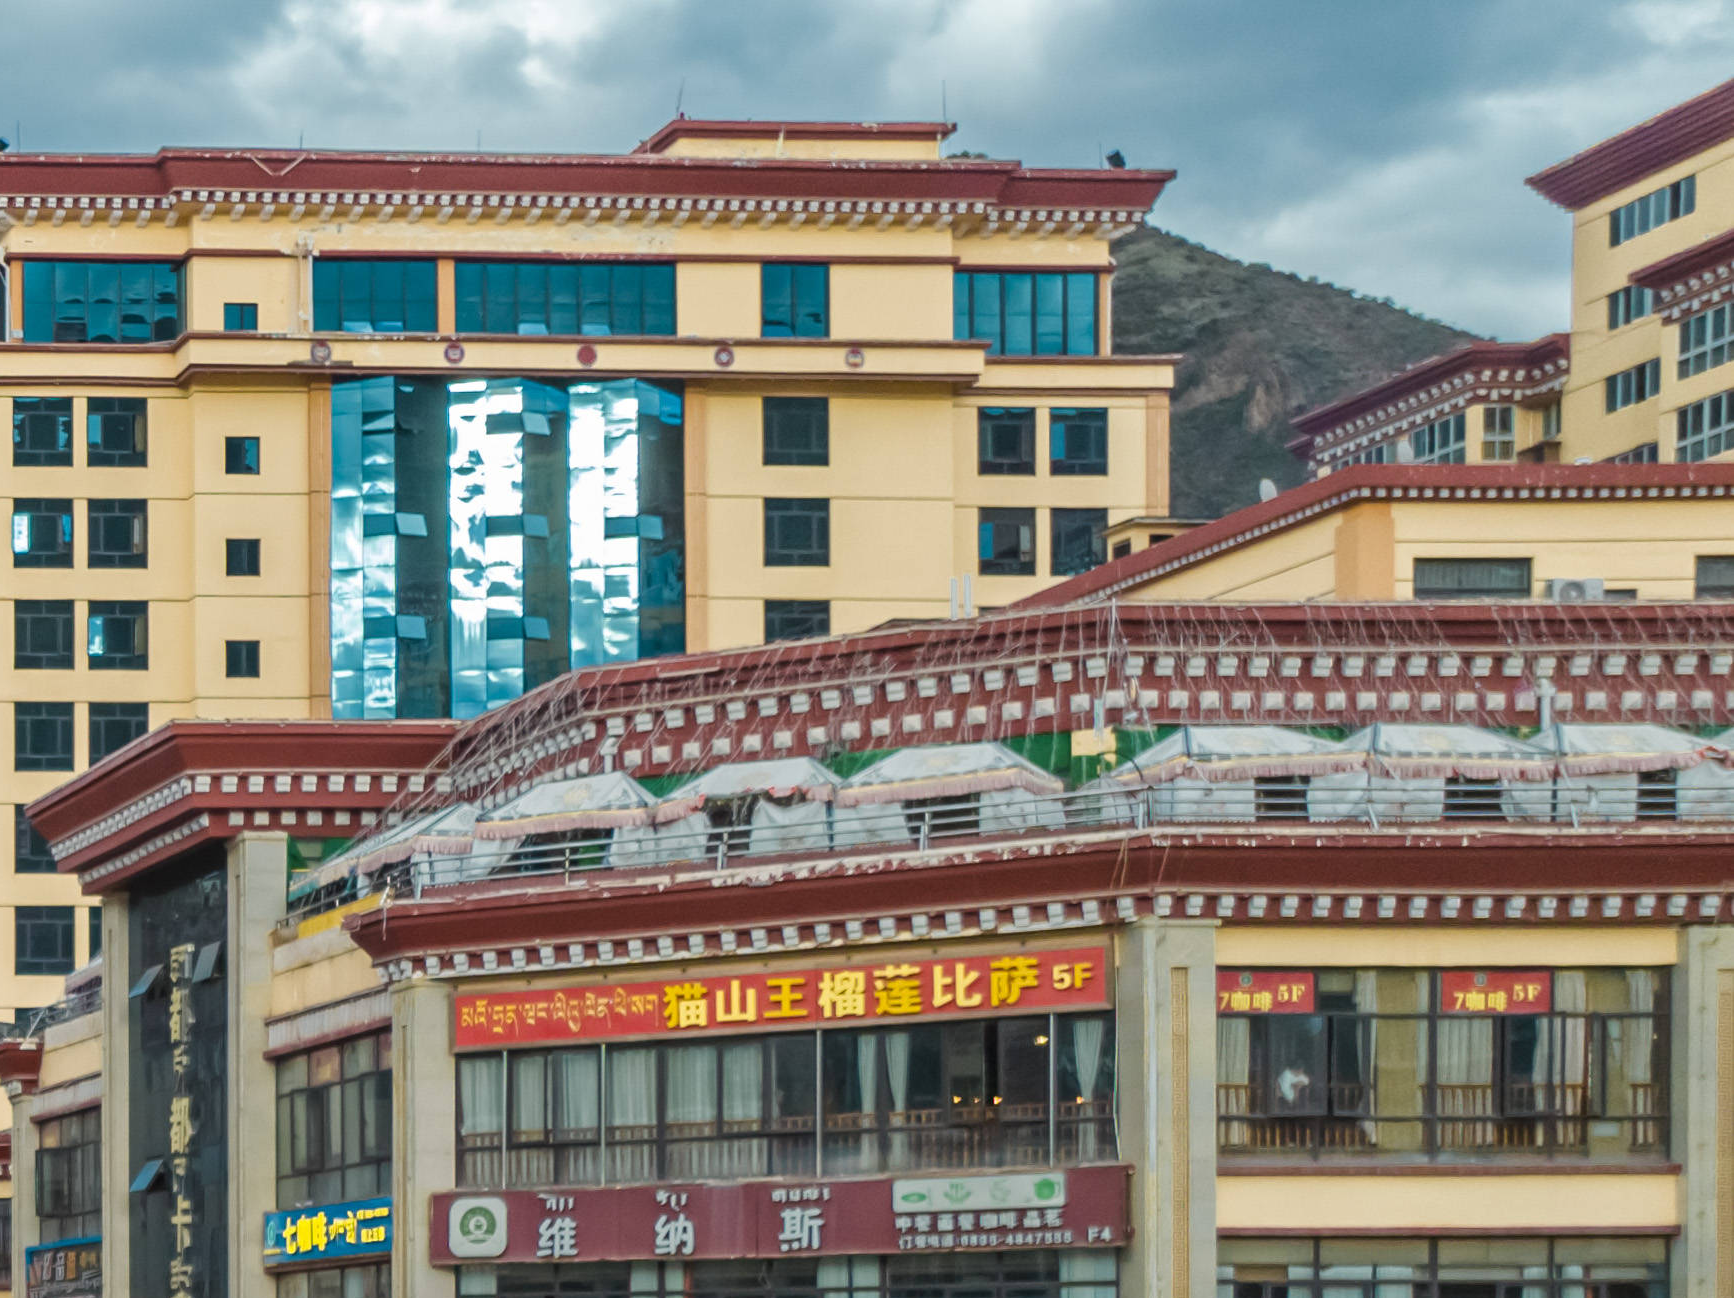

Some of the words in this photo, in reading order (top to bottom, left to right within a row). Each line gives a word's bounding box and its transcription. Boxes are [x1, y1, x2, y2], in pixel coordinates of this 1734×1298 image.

[663, 956, 1038, 1029] 猫山王榴莲比萨
[1052, 962, 1094, 990] 5F
[1278, 983, 1306, 1002] 5F
[1513, 983, 1542, 1002] 5F
[536, 1207, 824, 1257] 维纳斯
[1087, 1226, 1113, 1244] F4
